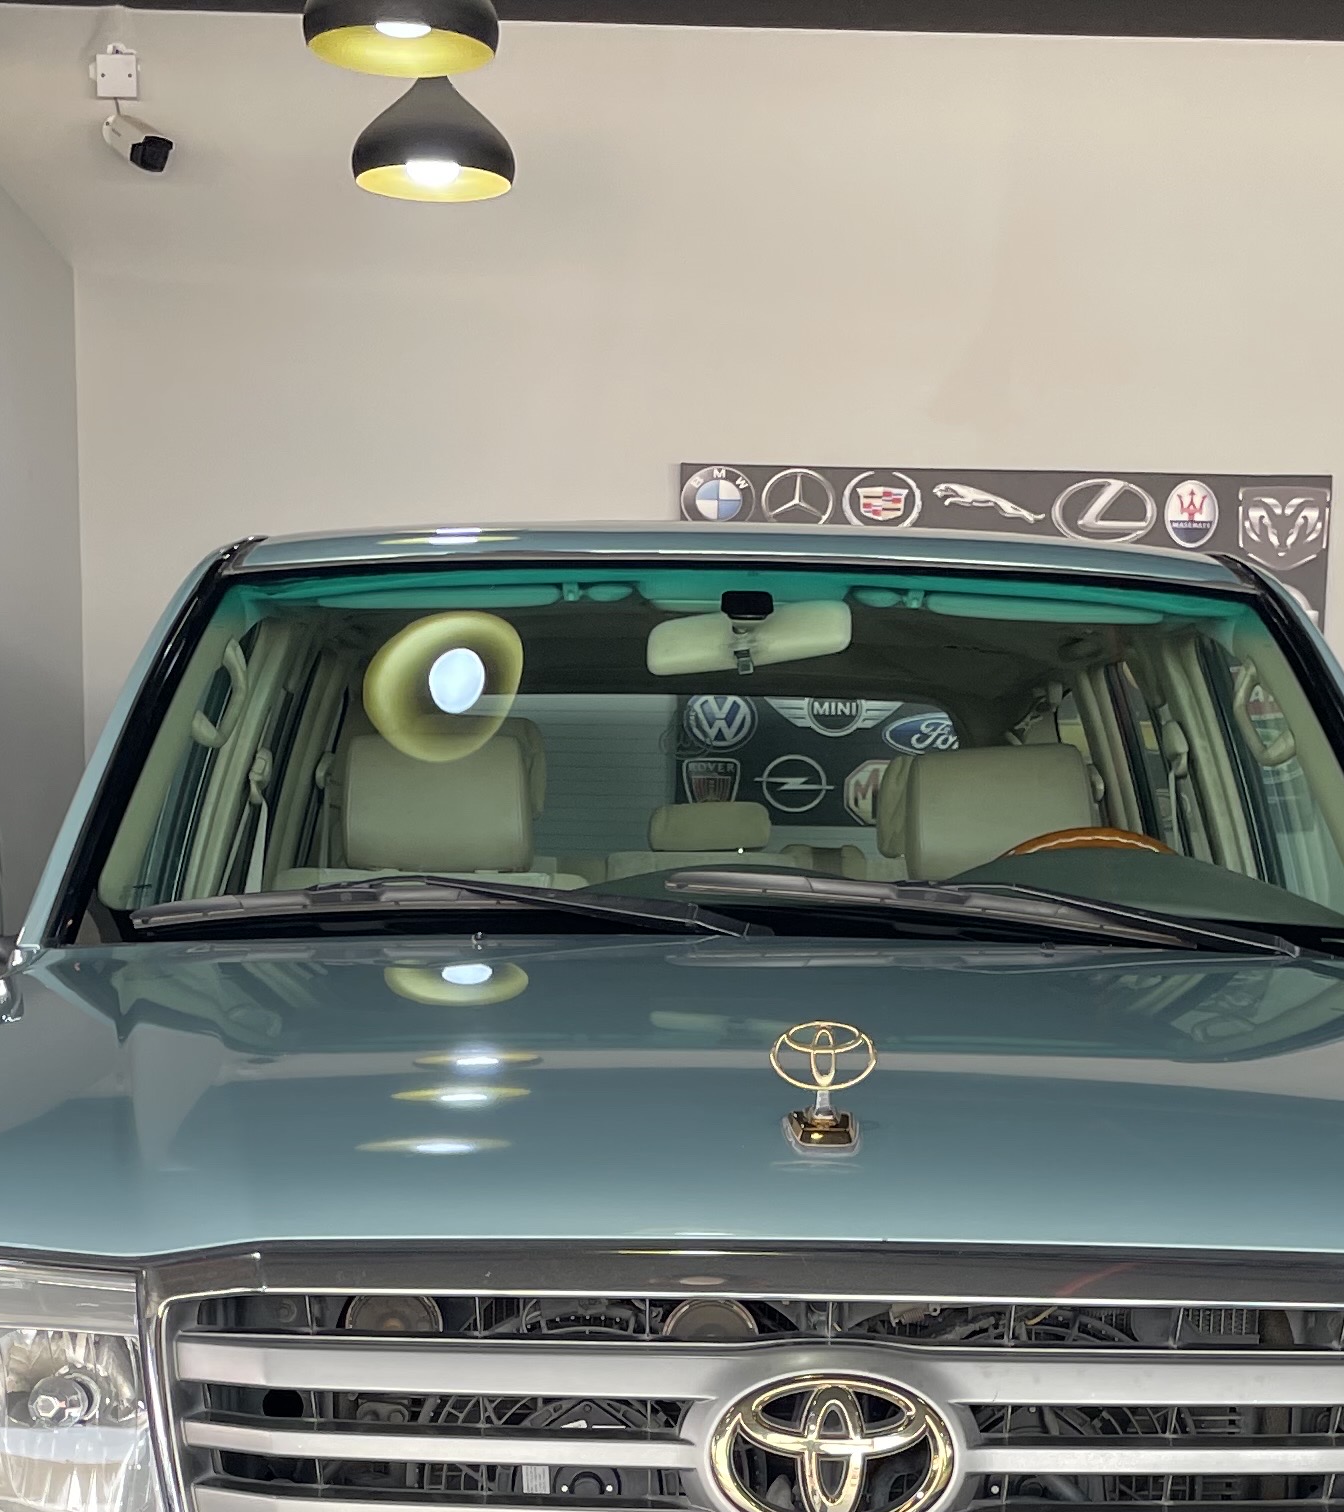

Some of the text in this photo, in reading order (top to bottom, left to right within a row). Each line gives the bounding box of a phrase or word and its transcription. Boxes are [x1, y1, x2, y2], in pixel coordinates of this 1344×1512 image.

[690, 467, 749, 489] BMW
[813, 701, 857, 716] MINI
[910, 719, 959, 750] Fo
